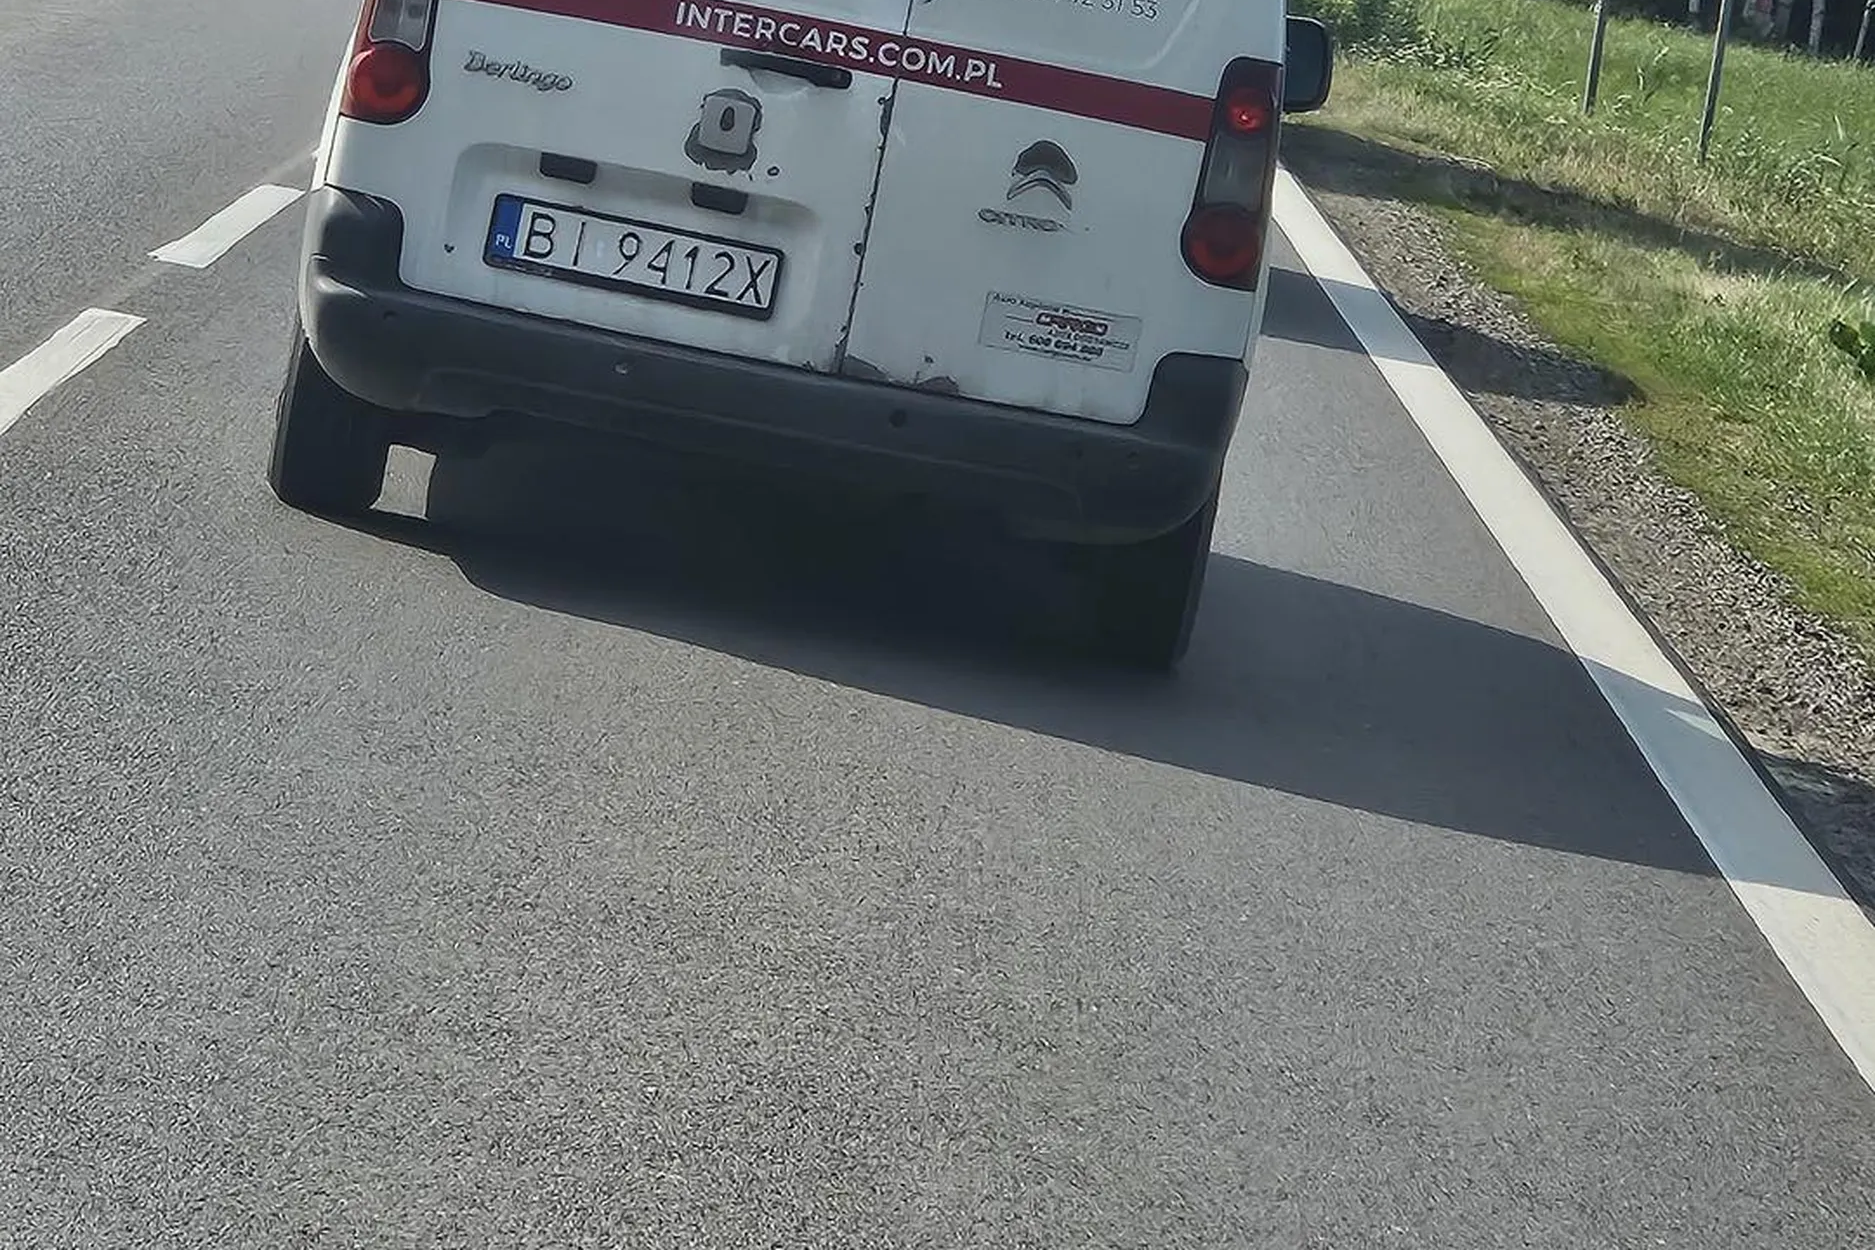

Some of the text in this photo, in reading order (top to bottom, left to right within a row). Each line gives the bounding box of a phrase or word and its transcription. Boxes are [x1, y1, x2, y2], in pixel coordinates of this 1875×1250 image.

[462, 49, 574, 92] Berlingo
[674, 0, 1004, 89] INTERCARS.COM.PL
[495, 233, 513, 250] PL
[523, 211, 772, 306] BI 9412X
